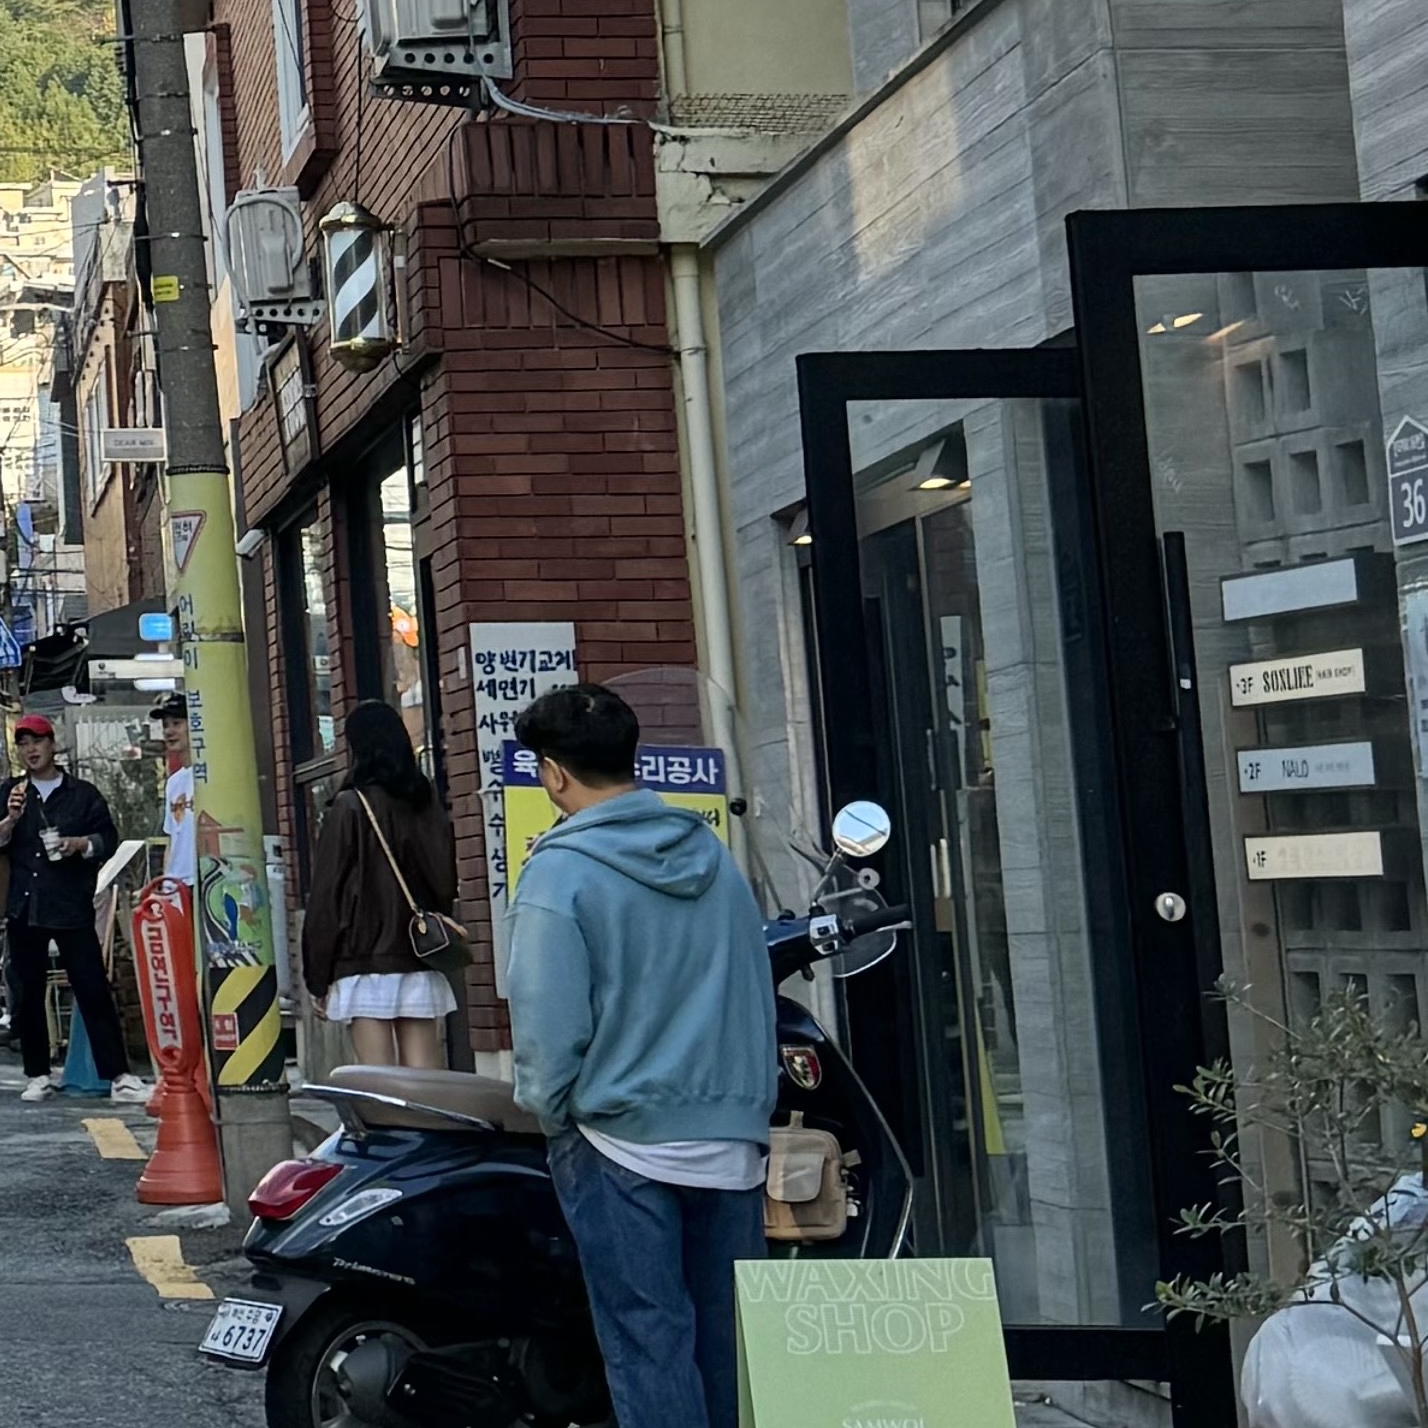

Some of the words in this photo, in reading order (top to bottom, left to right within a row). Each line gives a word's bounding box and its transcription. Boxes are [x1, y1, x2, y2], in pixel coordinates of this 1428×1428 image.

[1401, 478, 1426, 528] 36
[634, 755, 718, 785] 리공사
[741, 1260, 996, 1302] WAXING
[222, 1325, 267, 1352] 6737
[785, 1303, 964, 1354] SHOP
